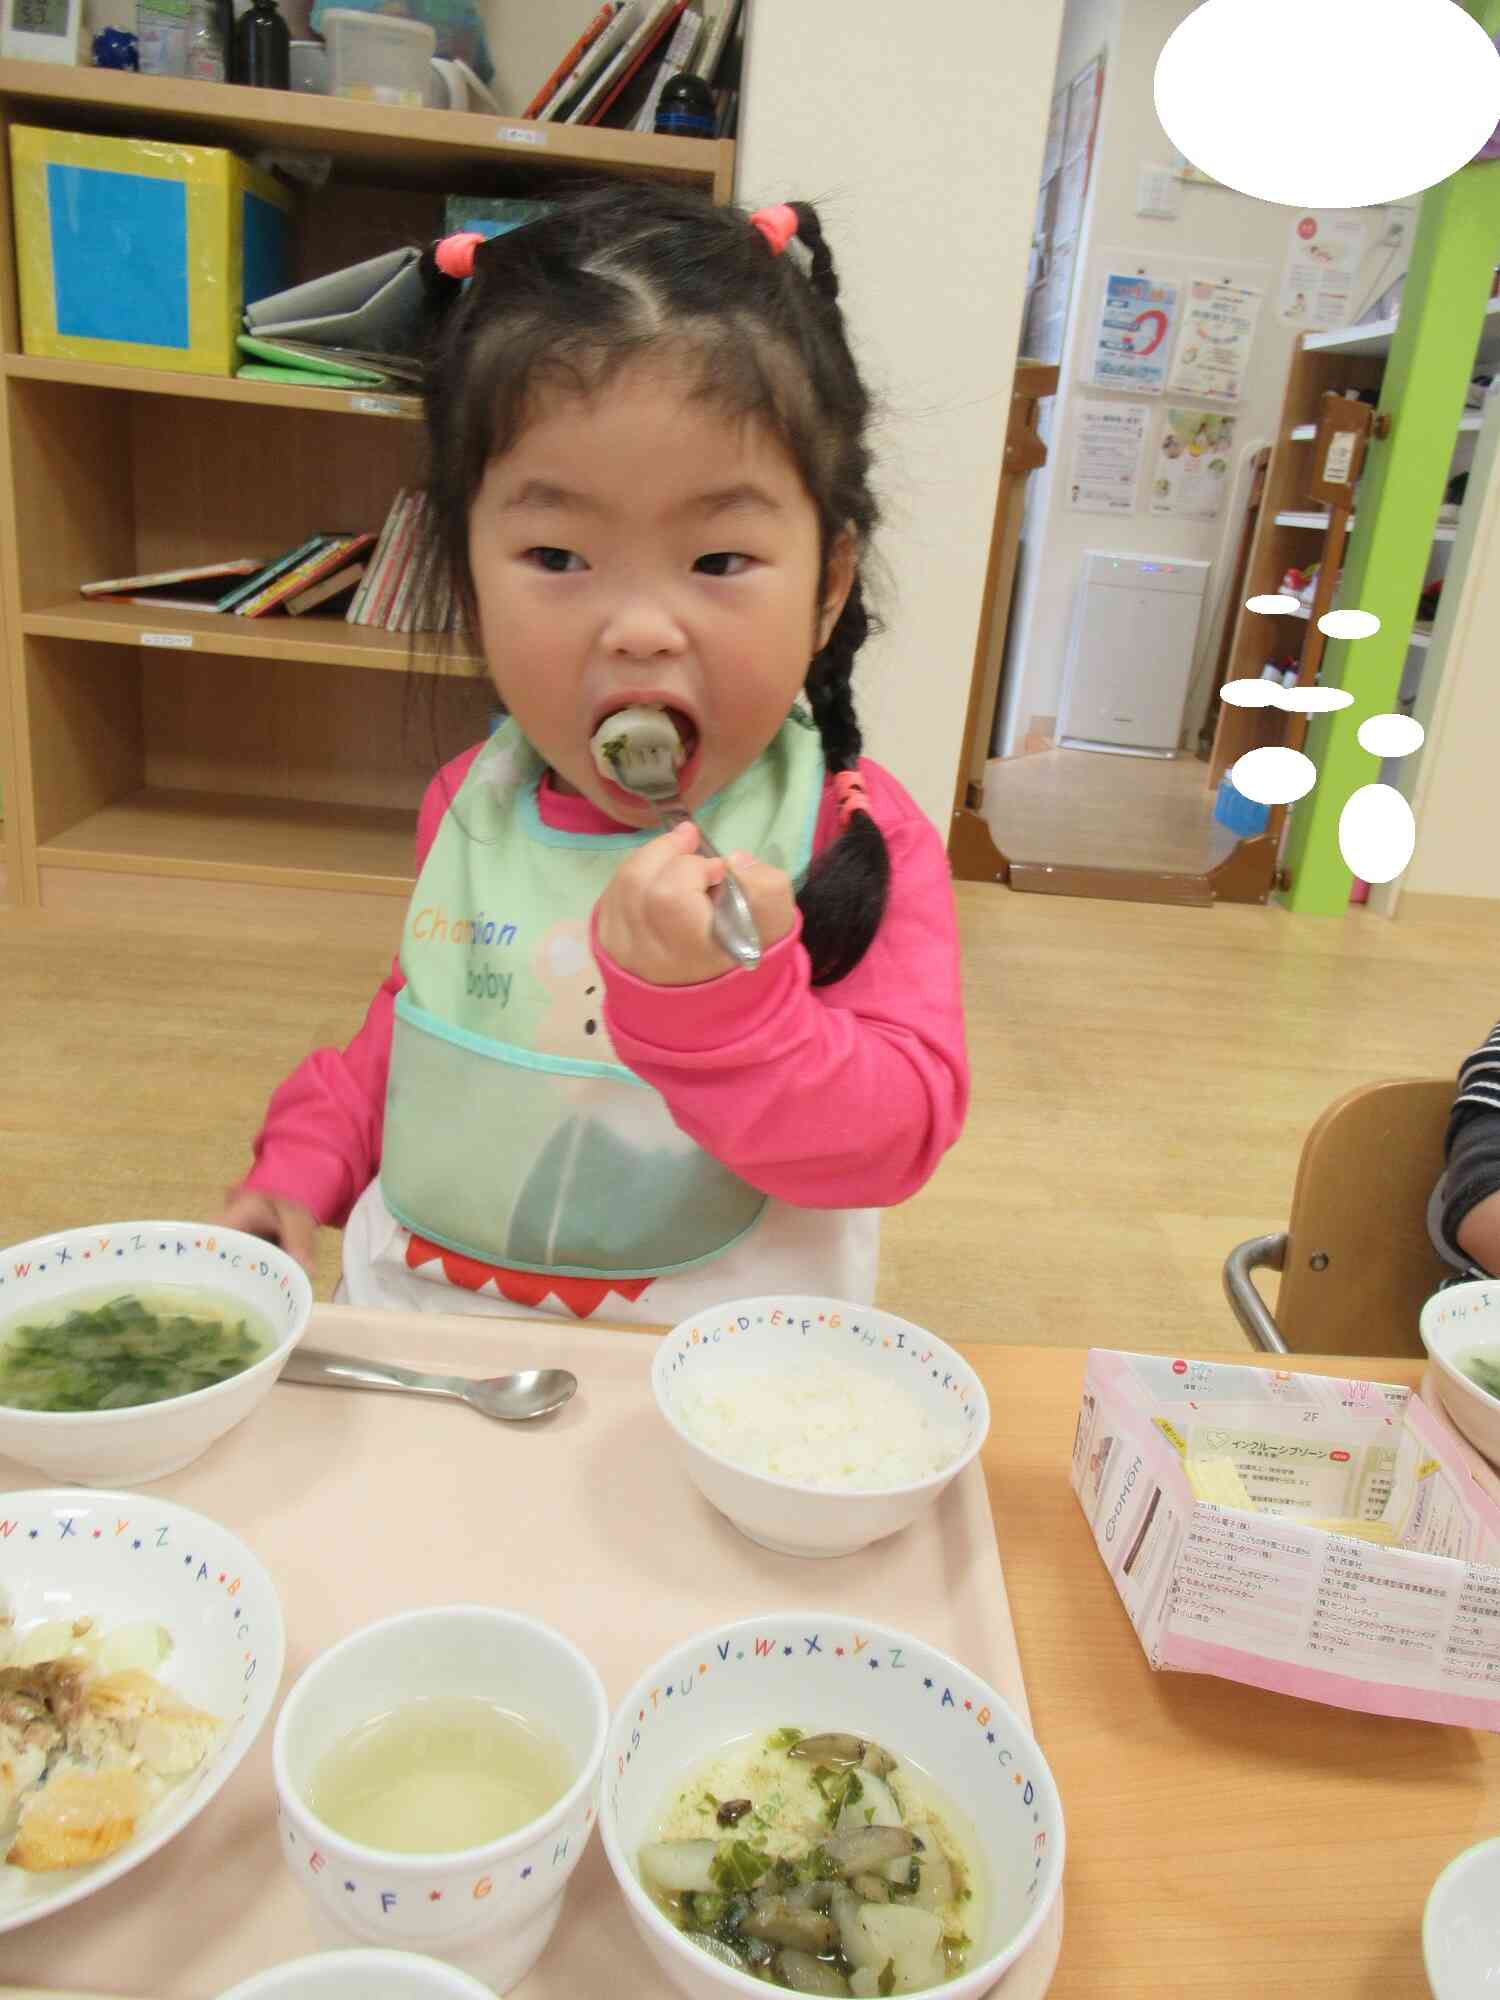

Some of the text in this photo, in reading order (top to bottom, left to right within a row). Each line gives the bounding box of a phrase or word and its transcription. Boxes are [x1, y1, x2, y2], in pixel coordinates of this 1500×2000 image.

[15, 1263, 32, 1278] W
[56, 1247, 72, 1265] X
[736, 1317, 750, 1332] D
[770, 1310, 784, 1327] E
[801, 1319, 812, 1336] F
[896, 1334, 906, 1349] I
[1303, 1411, 1320, 1422] 2F
[1231, 1439, 1327, 1459] インクルーシブゾーン
[57, 1518, 77, 1540] X
[113, 1518, 130, 1537] Y
[156, 1526, 169, 1547] Z
[196, 1562, 209, 1582] A
[680, 1678, 694, 1697] U
[717, 1640, 731, 1662] V
[754, 1638, 776, 1657] W
[803, 1634, 823, 1655] X
[851, 1634, 870, 1654] Y
[889, 1649, 906, 1669] Z
[940, 1687, 955, 1707] A
[309, 1850, 327, 1873] E
[380, 1892, 397, 1913] F
[472, 1876, 493, 1900] G
